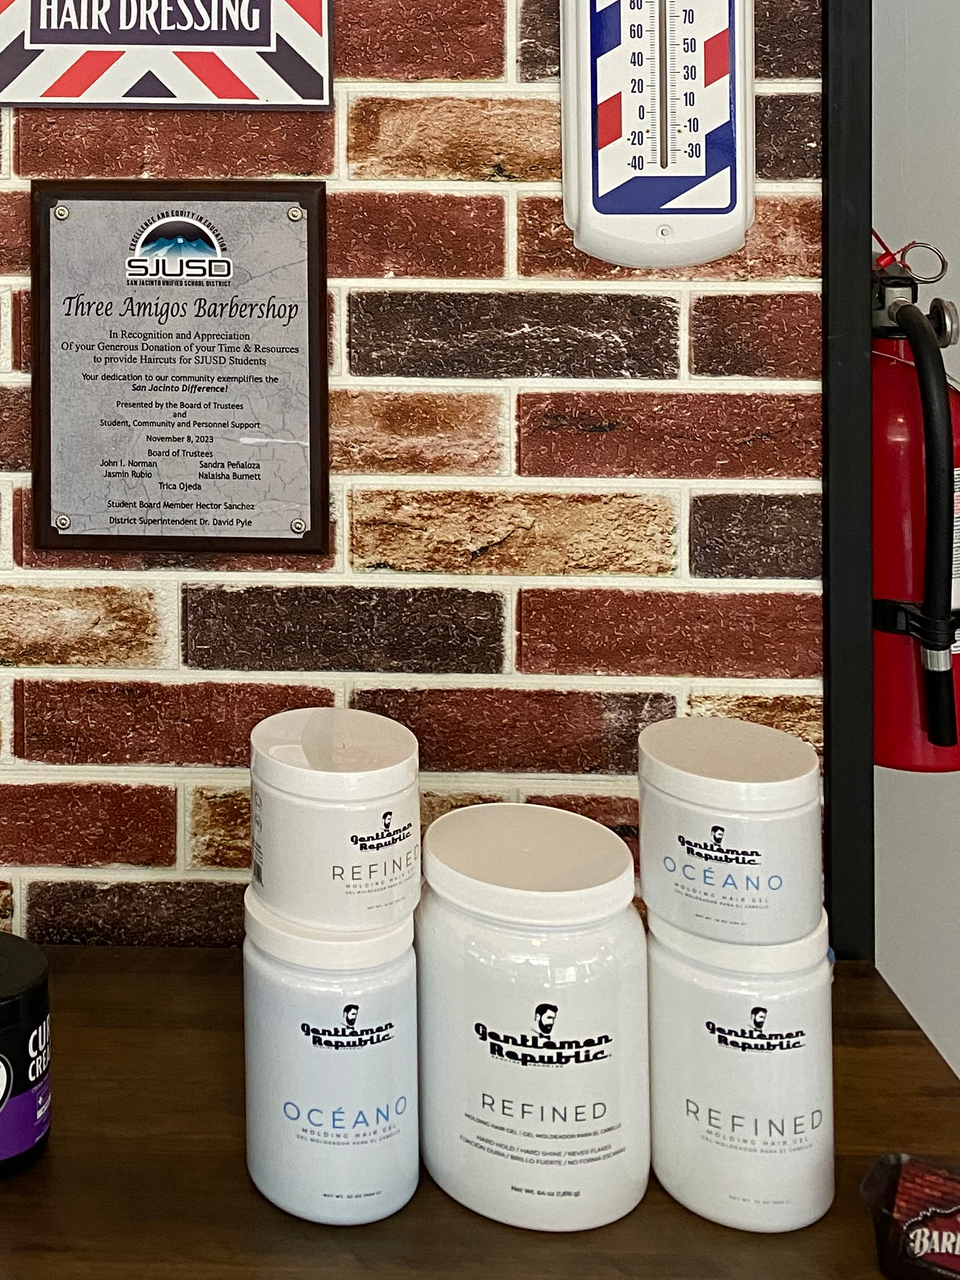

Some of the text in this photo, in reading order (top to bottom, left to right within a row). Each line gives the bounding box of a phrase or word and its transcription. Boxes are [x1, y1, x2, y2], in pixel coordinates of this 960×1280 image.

[128, 259, 230, 277] SJUSD
[62, 294, 298, 327] Three Amigos Barbershop
[109, 330, 250, 341] In Recognition and Appreciation
[147, 435, 185, 443] November
[187, 436, 193, 444] 8,
[148, 449, 213, 458] Board of Trustees
[360, 831, 411, 850] Republic
[333, 844, 419, 880] REFINED
[687, 847, 761, 865] Republic
[664, 857, 782, 890] OCÉANO
[312, 1034, 394, 1050] Republic
[718, 1035, 805, 1051] Republic
[490, 1042, 610, 1066] Republic
[283, 1096, 406, 1129] OCÉANO
[482, 1093, 607, 1122] REFINED
[686, 1099, 822, 1137] REFINED
